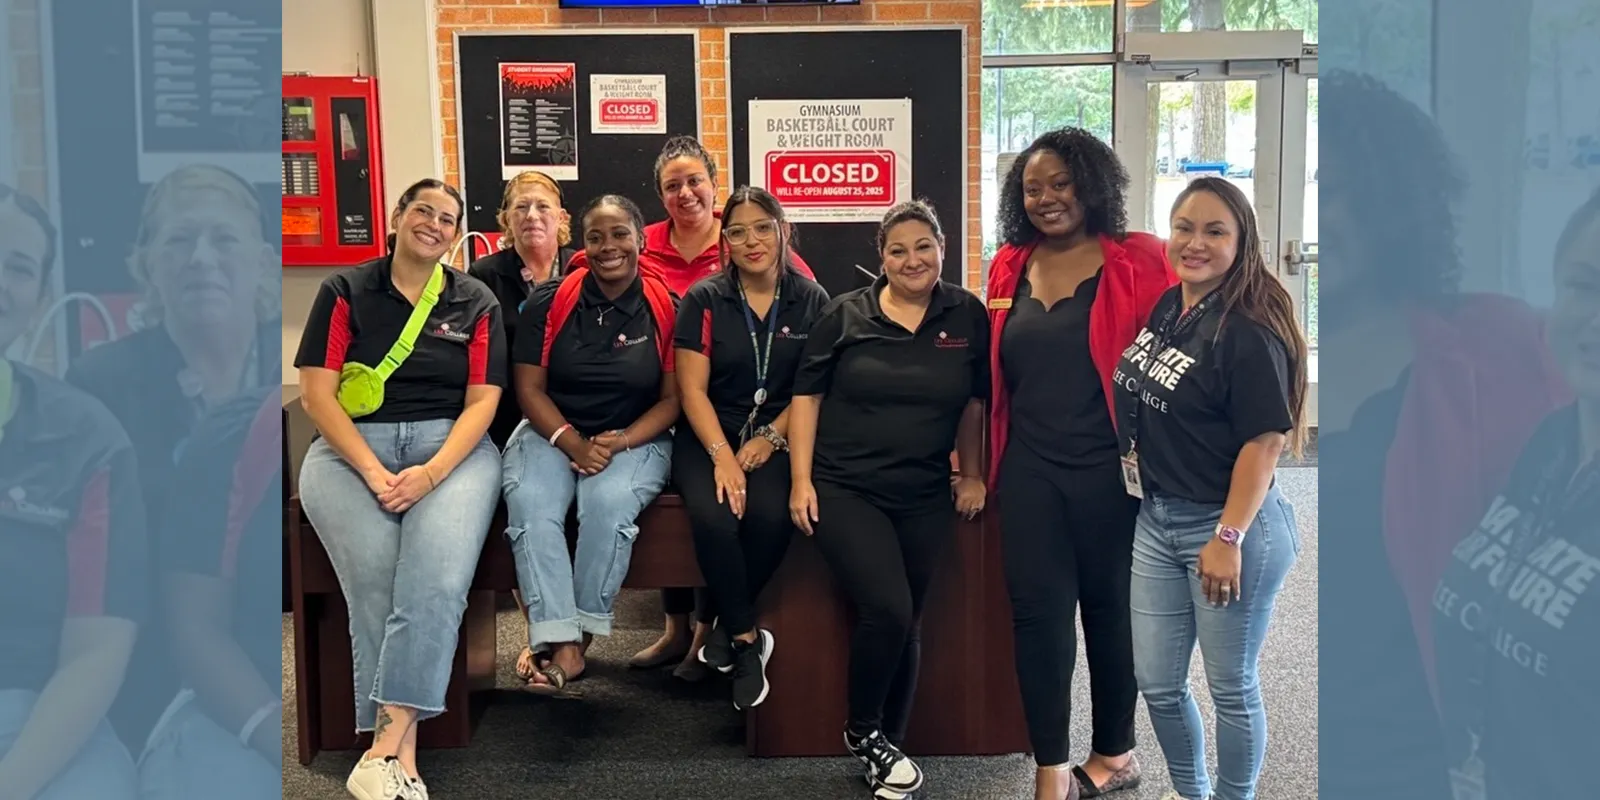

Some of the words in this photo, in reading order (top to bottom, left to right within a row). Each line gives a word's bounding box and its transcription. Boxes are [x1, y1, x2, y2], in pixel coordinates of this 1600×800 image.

[607, 104, 651, 114] CLOSED
[800, 105, 861, 116] GYMNASIUM
[767, 117, 848, 132] BASKETBALL
[852, 118, 895, 132] COURT
[777, 134, 787, 148] &
[790, 134, 842, 147] WEIGHT
[845, 133, 884, 147] ROOM
[782, 163, 879, 184] CLOSED
[776, 187, 793, 196] WILL
[793, 187, 822, 196] RE-OPEN
[823, 187, 852, 195] AUGUST
[853, 187, 865, 196] 25,
[865, 187, 884, 195] 2025
